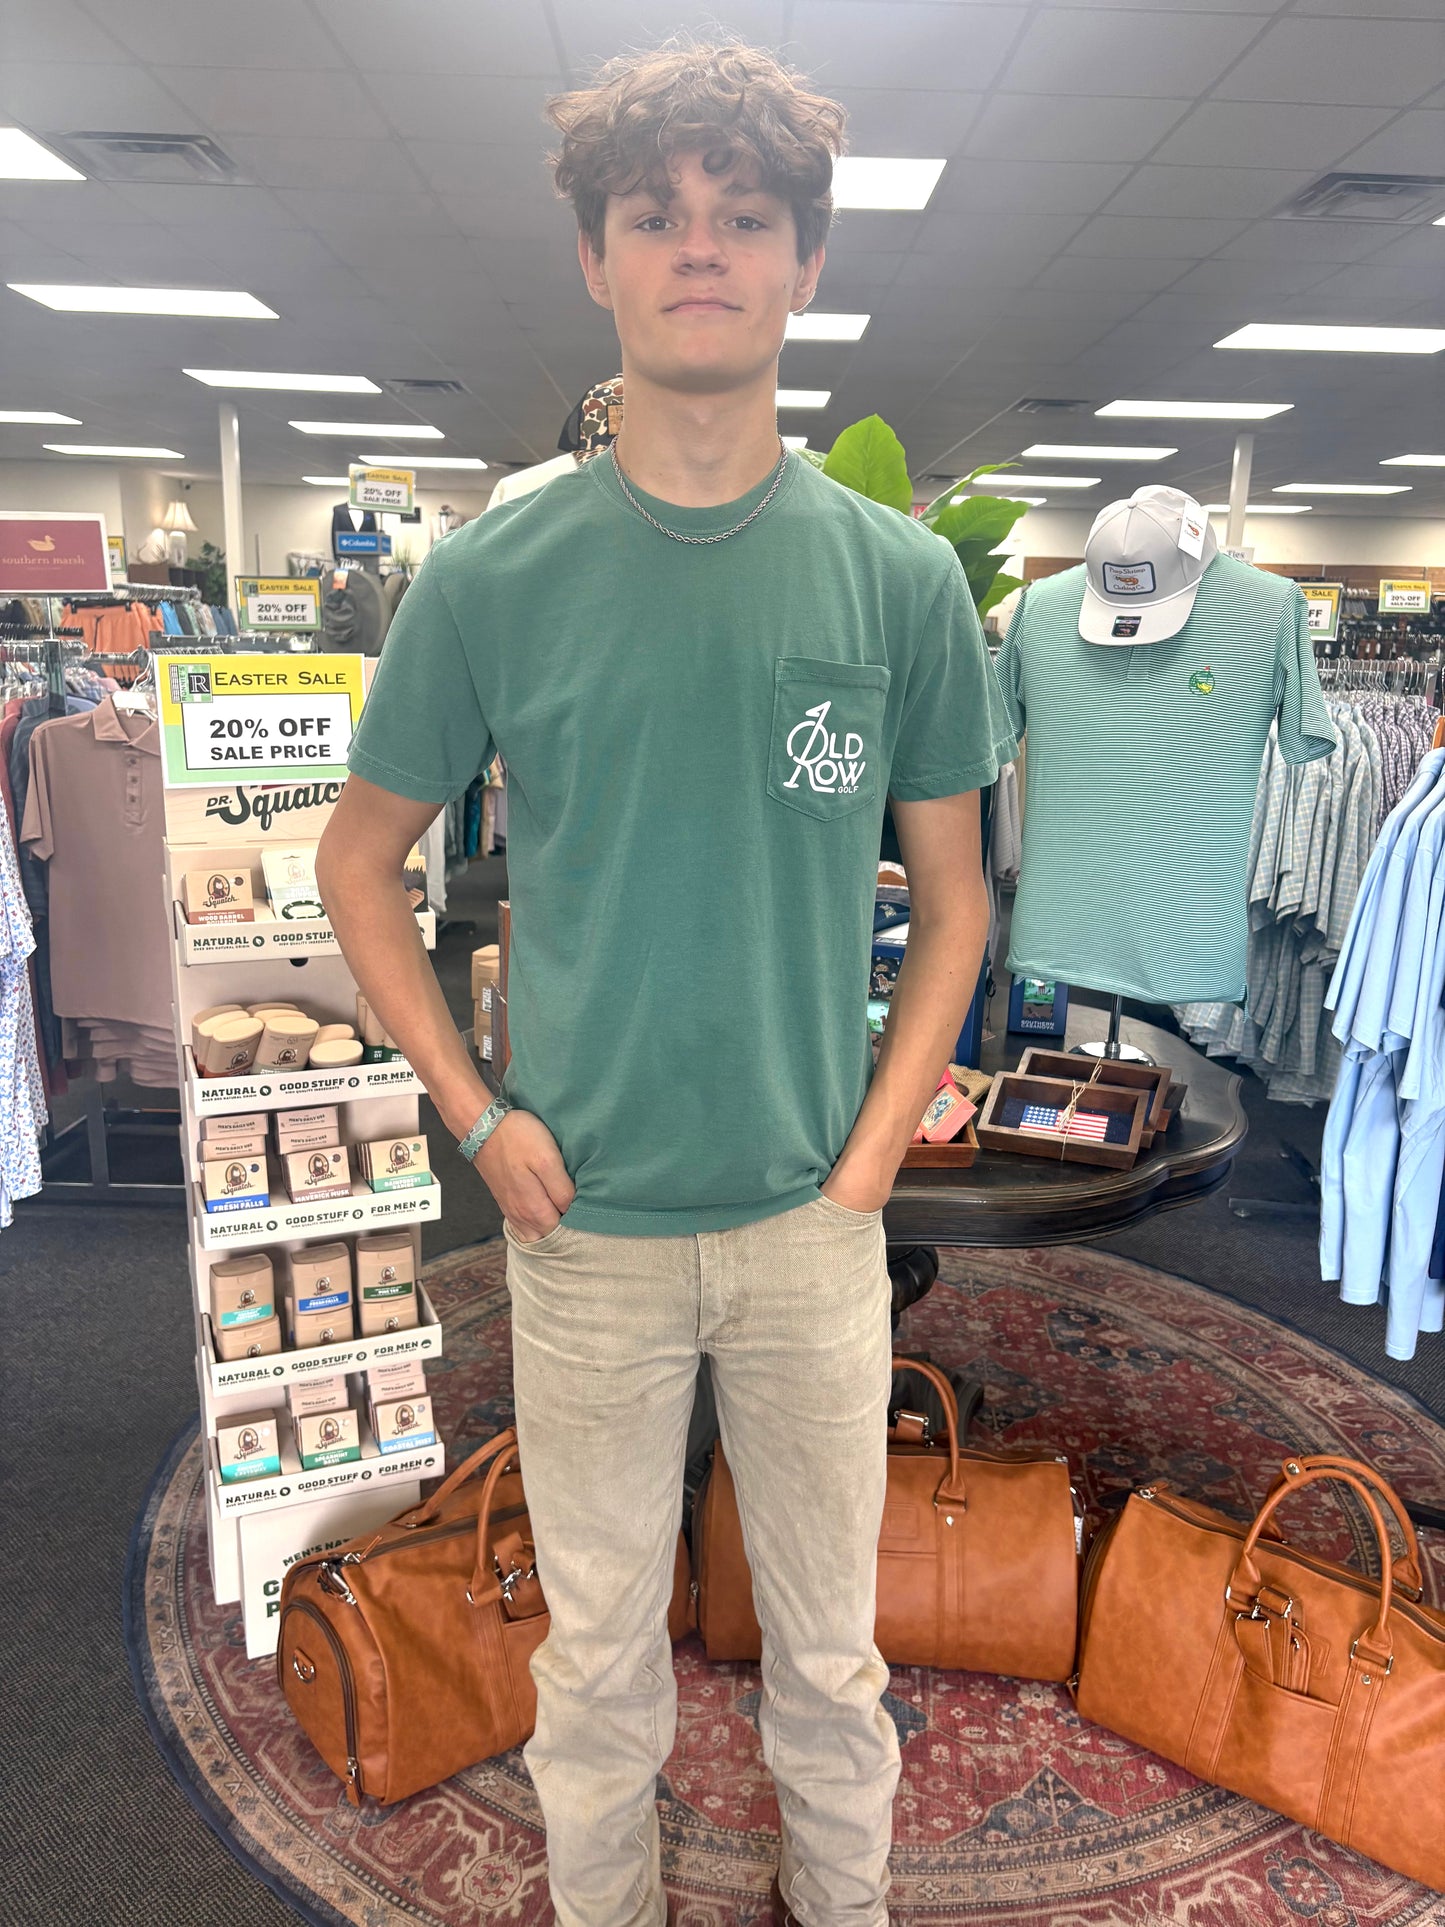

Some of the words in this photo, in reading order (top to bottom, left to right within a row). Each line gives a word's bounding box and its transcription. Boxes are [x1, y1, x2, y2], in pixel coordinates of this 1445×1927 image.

[363, 487, 382, 495] 20%
[384, 489, 402, 497] OFF
[1, 554, 50, 565] southern
[53, 554, 85, 565] marsh
[257, 604, 282, 613] 20%
[285, 604, 307, 613] OFF
[190, 675, 209, 693] R
[214, 672, 288, 686] EASTER
[298, 671, 347, 685] SALE
[209, 718, 269, 739] 20%
[278, 717, 332, 737] OFF
[210, 746, 264, 761] SALE
[270, 744, 331, 759] PRICE
[837, 785, 860, 794] GOLF
[205, 782, 346, 831] Squatc
[206, 795, 233, 808] DR.
[218, 913, 245, 921] BARREL
[193, 936, 249, 947] NATURAL
[272, 933, 304, 942] GOOD
[305, 931, 336, 940] STUF
[201, 1086, 257, 1098] NATURAL
[279, 1081, 309, 1091] GOOD
[311, 1077, 345, 1088] STUFF
[367, 1073, 388, 1083] FOR
[390, 1070, 414, 1080] MEN
[295, 1191, 330, 1203] MAVERICK
[330, 1188, 350, 1198] MUSK
[213, 1203, 240, 1213] FRESH
[240, 1200, 264, 1210] FALLS
[210, 1221, 264, 1235] NATURAL
[285, 1214, 315, 1226] GOOD
[316, 1210, 350, 1222] STUFF
[370, 1204, 391, 1214] FOR
[393, 1200, 417, 1211] MEN
[218, 1368, 270, 1383] NATURAL
[291, 1359, 320, 1370] GOOD
[321, 1353, 354, 1365] STUFF
[374, 1345, 394, 1356] FOR
[396, 1340, 419, 1352] MEN
[383, 1441, 415, 1453] COASTAL
[314, 1451, 348, 1463] SPEARMINT
[225, 1489, 277, 1504] NATURAL
[298, 1479, 326, 1490] GOOD
[327, 1472, 359, 1485] STUFF
[379, 1464, 398, 1474] FOR
[400, 1459, 422, 1470] MEN
[282, 1544, 323, 1567] MEN'S
